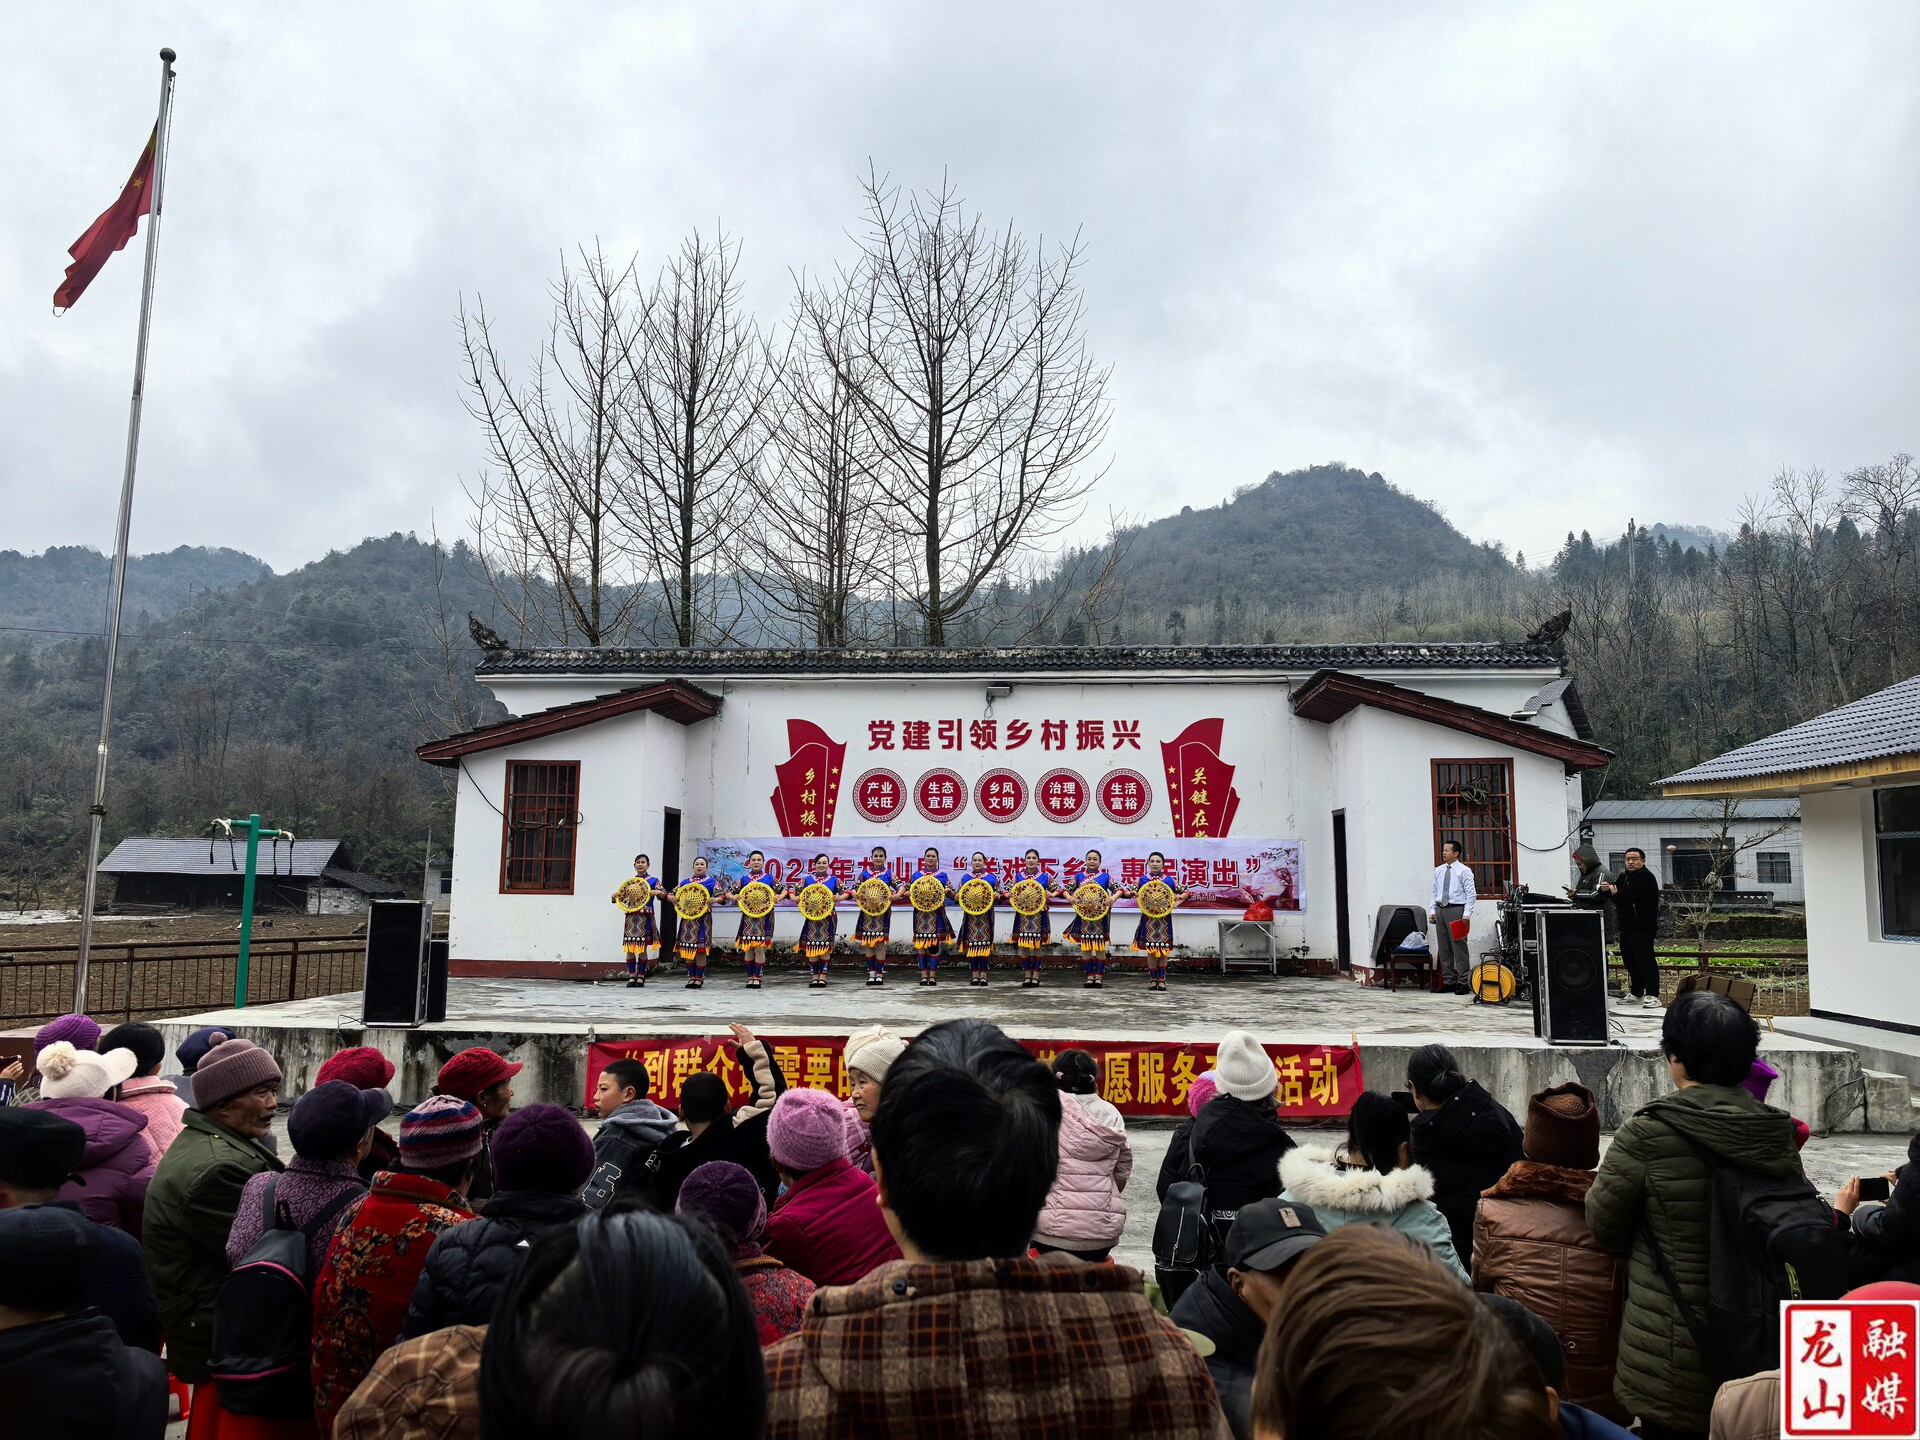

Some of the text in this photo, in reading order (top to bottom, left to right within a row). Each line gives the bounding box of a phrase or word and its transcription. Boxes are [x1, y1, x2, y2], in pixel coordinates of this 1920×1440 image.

[868, 718, 1141, 751] 党建引领乡村振兴
[867, 782, 893, 794] 产业
[928, 782, 954, 794] 生态
[989, 782, 1015, 794] 乡风
[1049, 782, 1076, 794] 治理
[1110, 782, 1137, 795] 生活
[867, 796, 893, 809] 兴旺
[928, 796, 954, 809] 宜居
[988, 796, 1014, 809] 文明
[1049, 796, 1076, 809] 有效
[1110, 797, 1138, 810] 富裕
